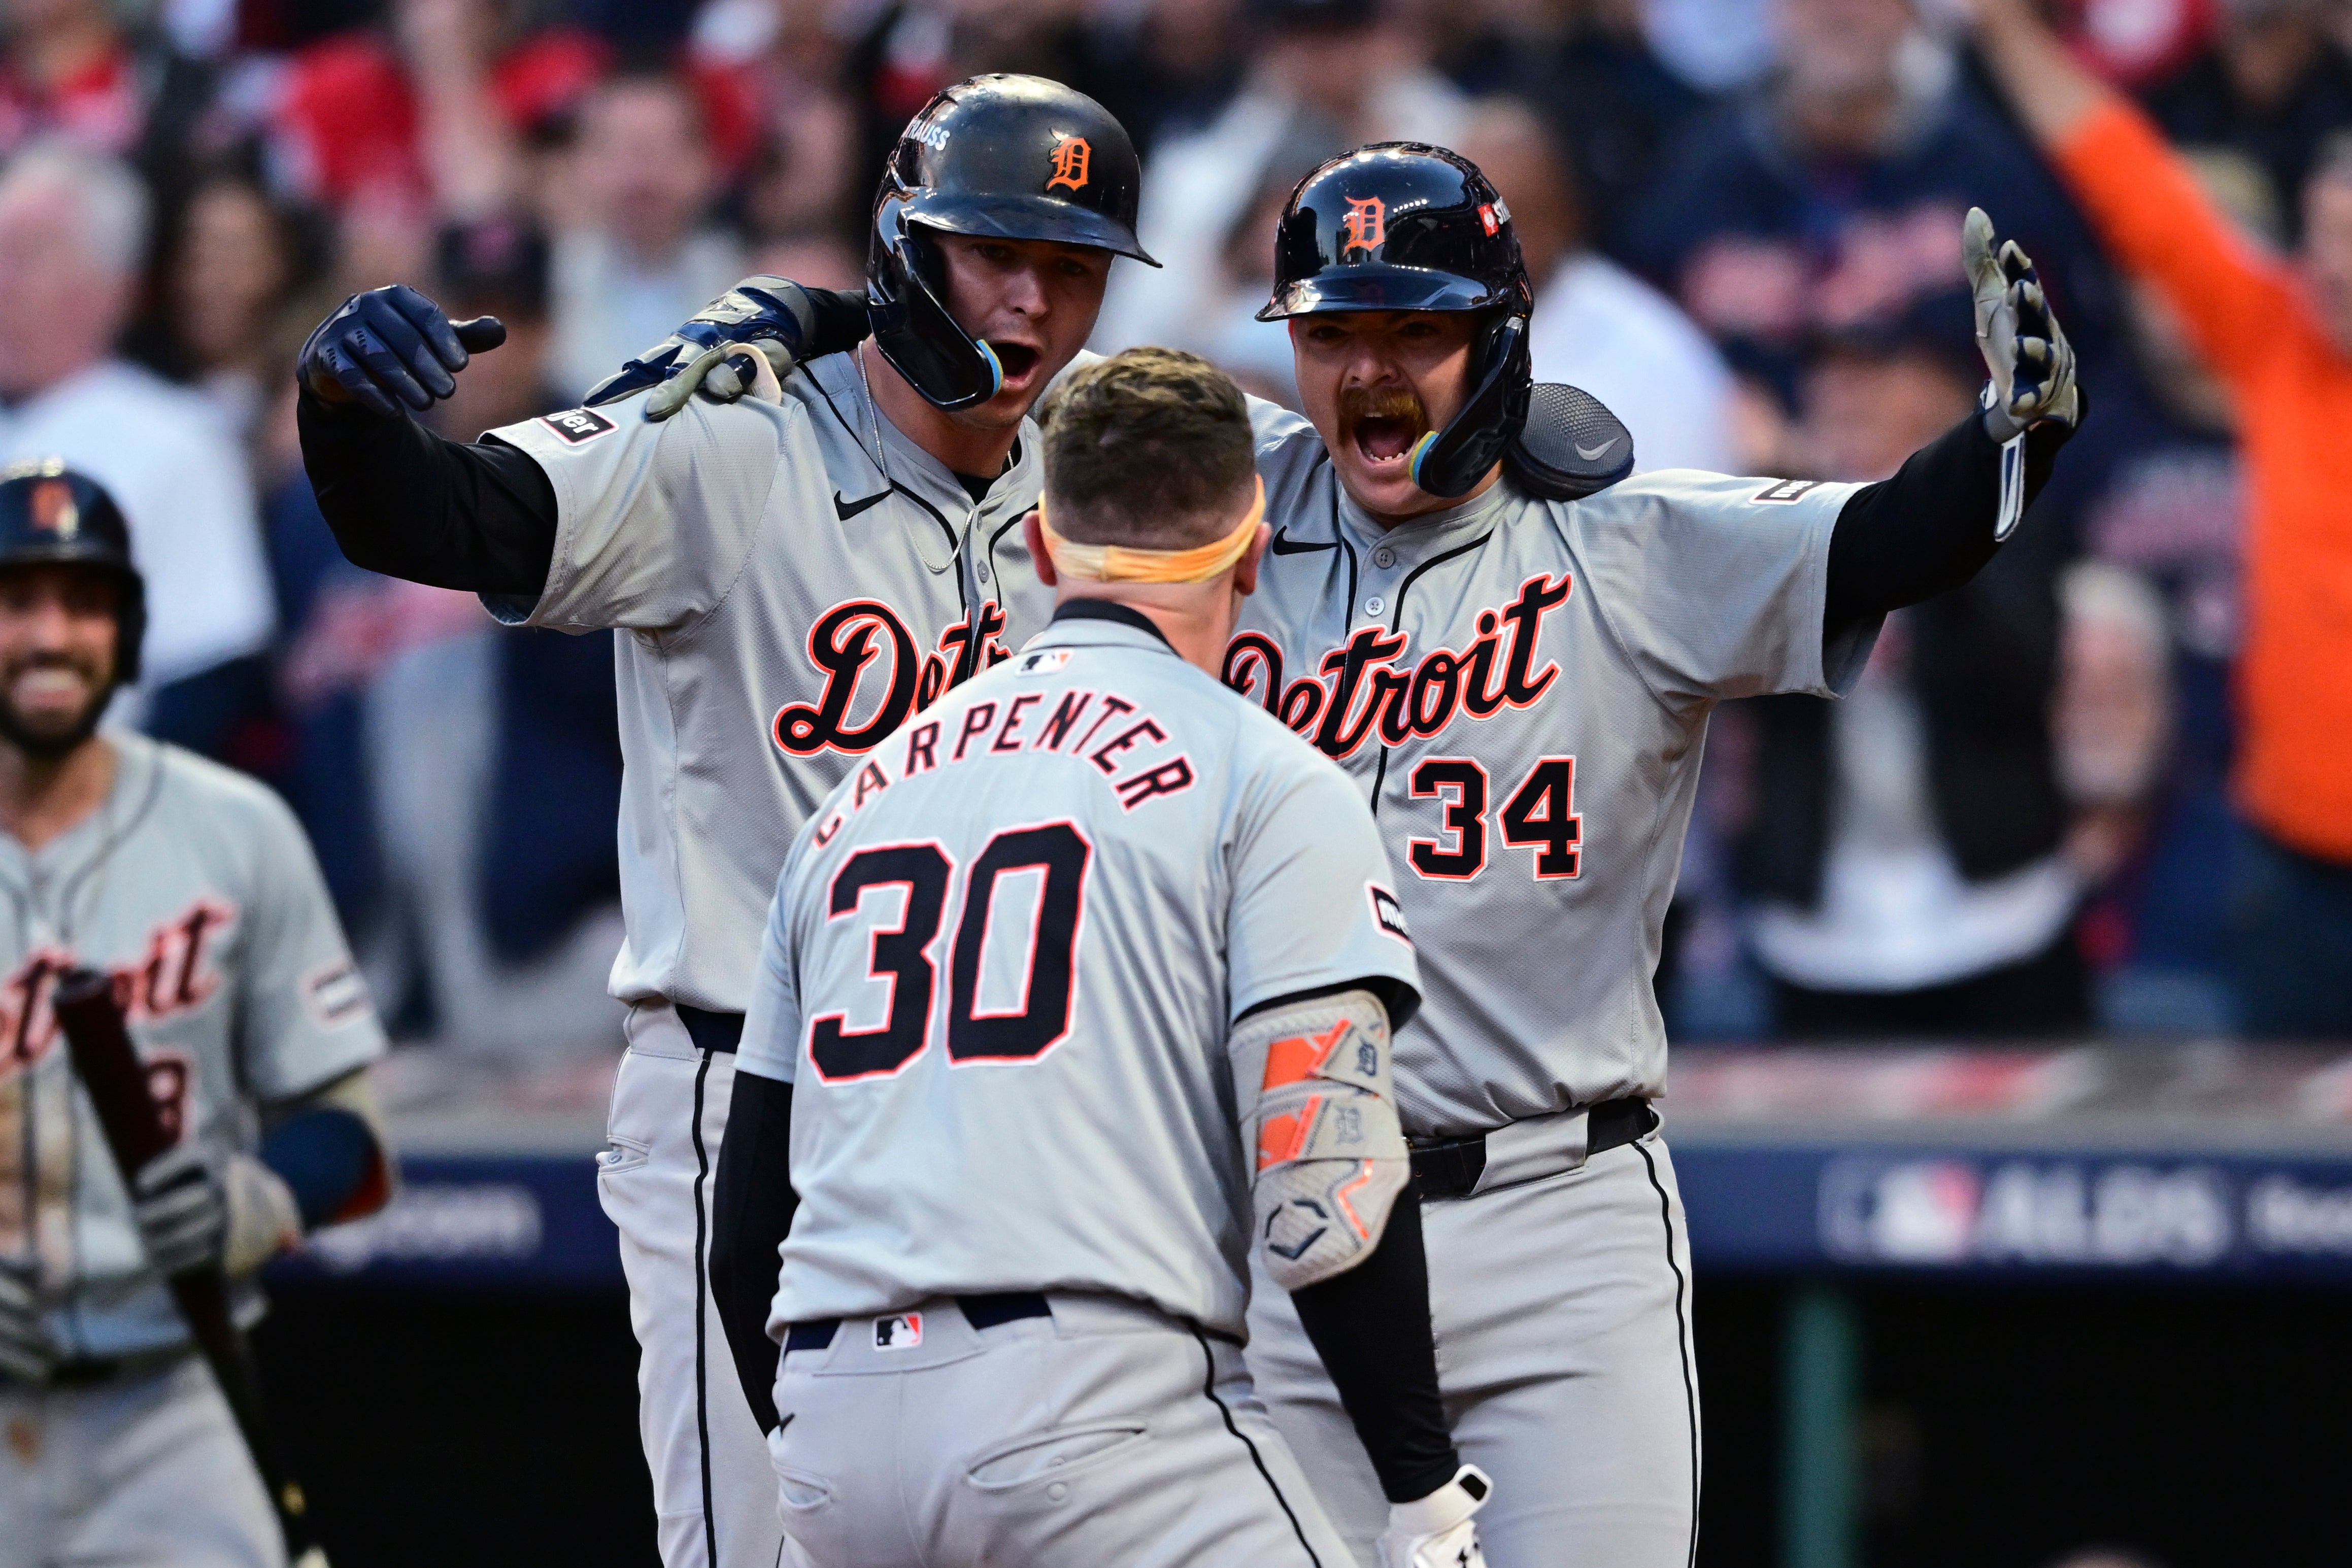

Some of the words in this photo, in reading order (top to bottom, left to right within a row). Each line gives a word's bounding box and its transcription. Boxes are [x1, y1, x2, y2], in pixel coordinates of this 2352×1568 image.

[1047, 128, 1092, 192] D
[1343, 196, 1385, 255] D
[813, 689, 1198, 850] CARPENTER
[1406, 755, 1583, 883] 34
[809, 817, 1096, 1086] 30
